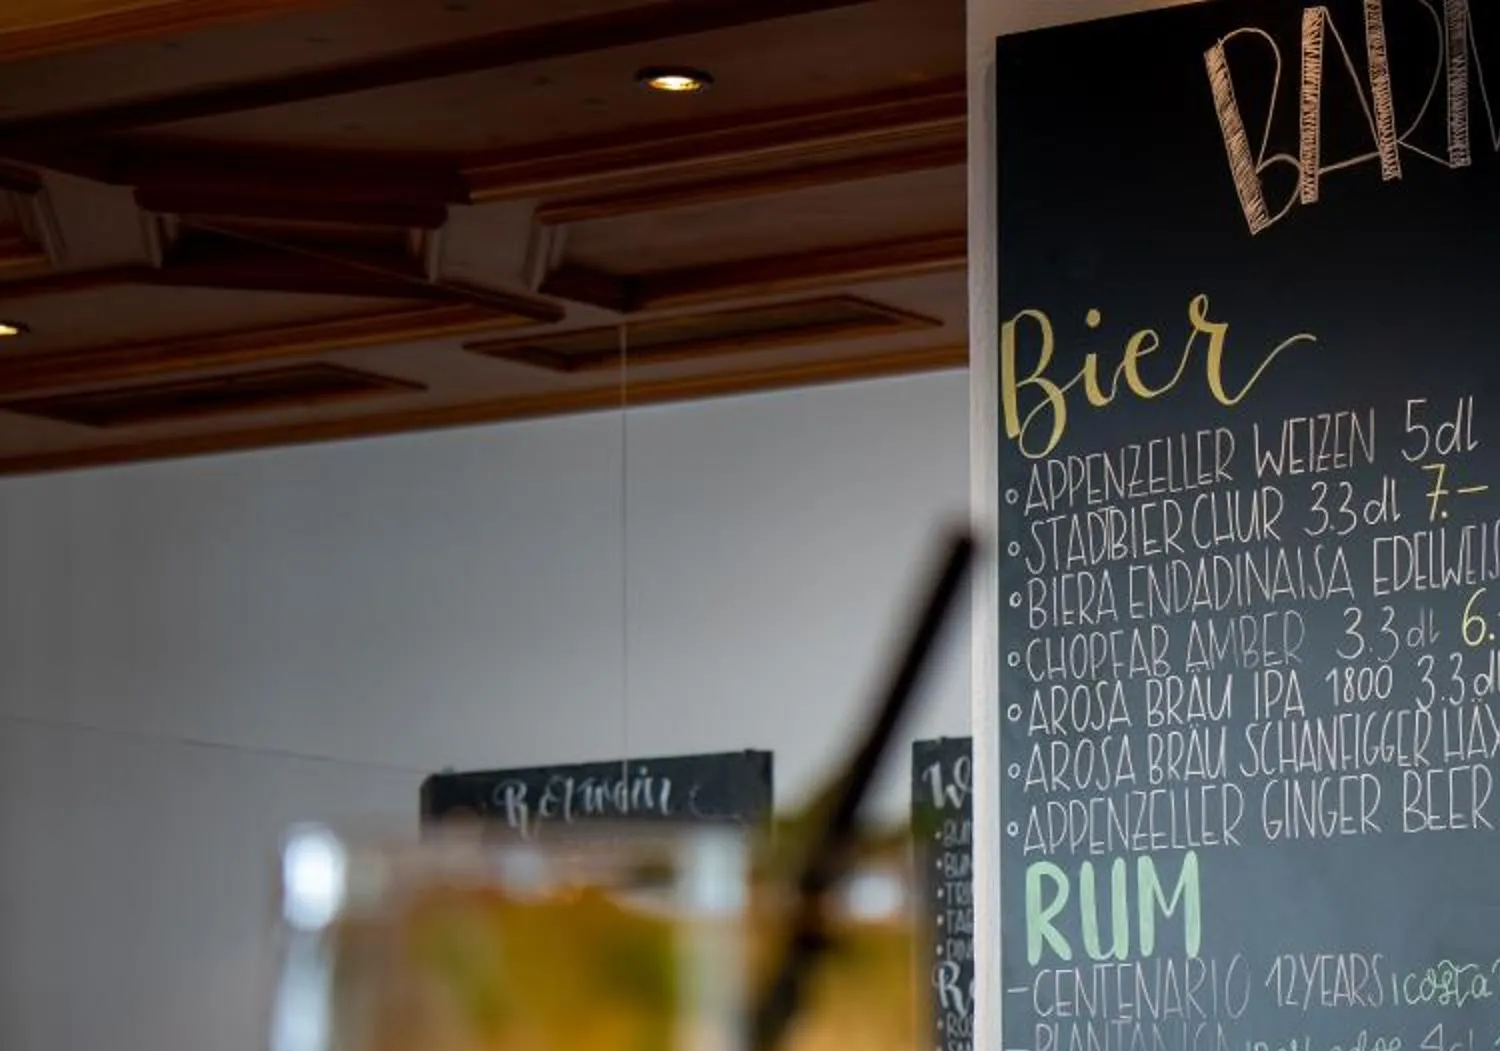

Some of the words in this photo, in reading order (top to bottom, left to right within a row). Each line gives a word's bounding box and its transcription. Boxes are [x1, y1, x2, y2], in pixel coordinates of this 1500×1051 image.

[1001, 293, 1317, 459] Bier
[1023, 427, 1235, 517] APPENZELLER
[1253, 407, 1375, 479] WEIZEN
[1191, 486, 1284, 549] CHUR
[1027, 569, 1118, 630] BIERA
[1025, 623, 1170, 682] CHOPFAB
[1185, 609, 1306, 673] AMBER
[1027, 679, 1133, 737] AROSA
[1254, 669, 1305, 720] IPA
[1324, 665, 1394, 707] 1800
[1023, 733, 1136, 793] AROSA
[1239, 702, 1433, 778] SCHANFIGGER
[1023, 782, 1245, 856] APPENZELLER
[1261, 773, 1383, 841] GINGER
[1402, 763, 1495, 833] BEER
[1025, 850, 1200, 967] RUM
